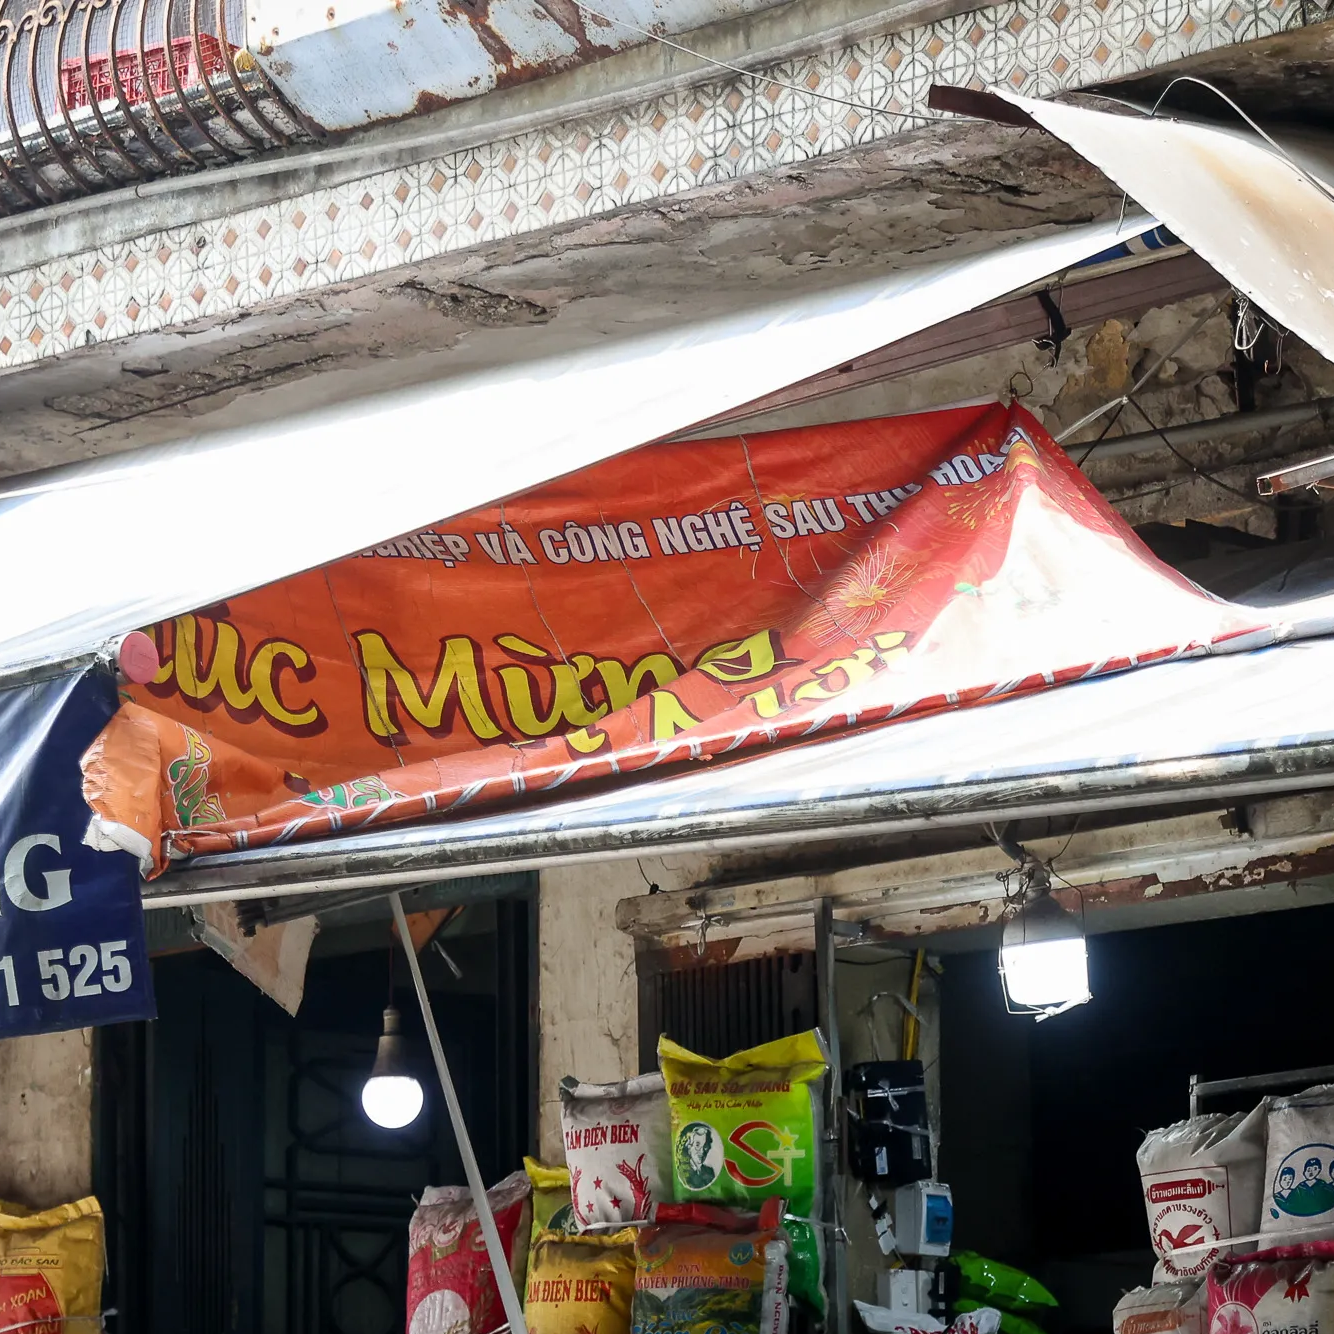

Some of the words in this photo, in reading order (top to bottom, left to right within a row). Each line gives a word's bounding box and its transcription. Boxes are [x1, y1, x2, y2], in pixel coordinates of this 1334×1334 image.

[474, 523, 538, 565] VÀ
[539, 520, 650, 564] CÔNG
[654, 506, 763, 555] NGHỆ
[764, 496, 847, 539] SAU
[36, 939, 134, 1001] 525
[584, 1121, 609, 1152] ĐIỆN
[610, 1118, 640, 1145] BIÊN
[541, 1272, 571, 1309] ĐIỆN
[574, 1272, 612, 1303] BIÊN
